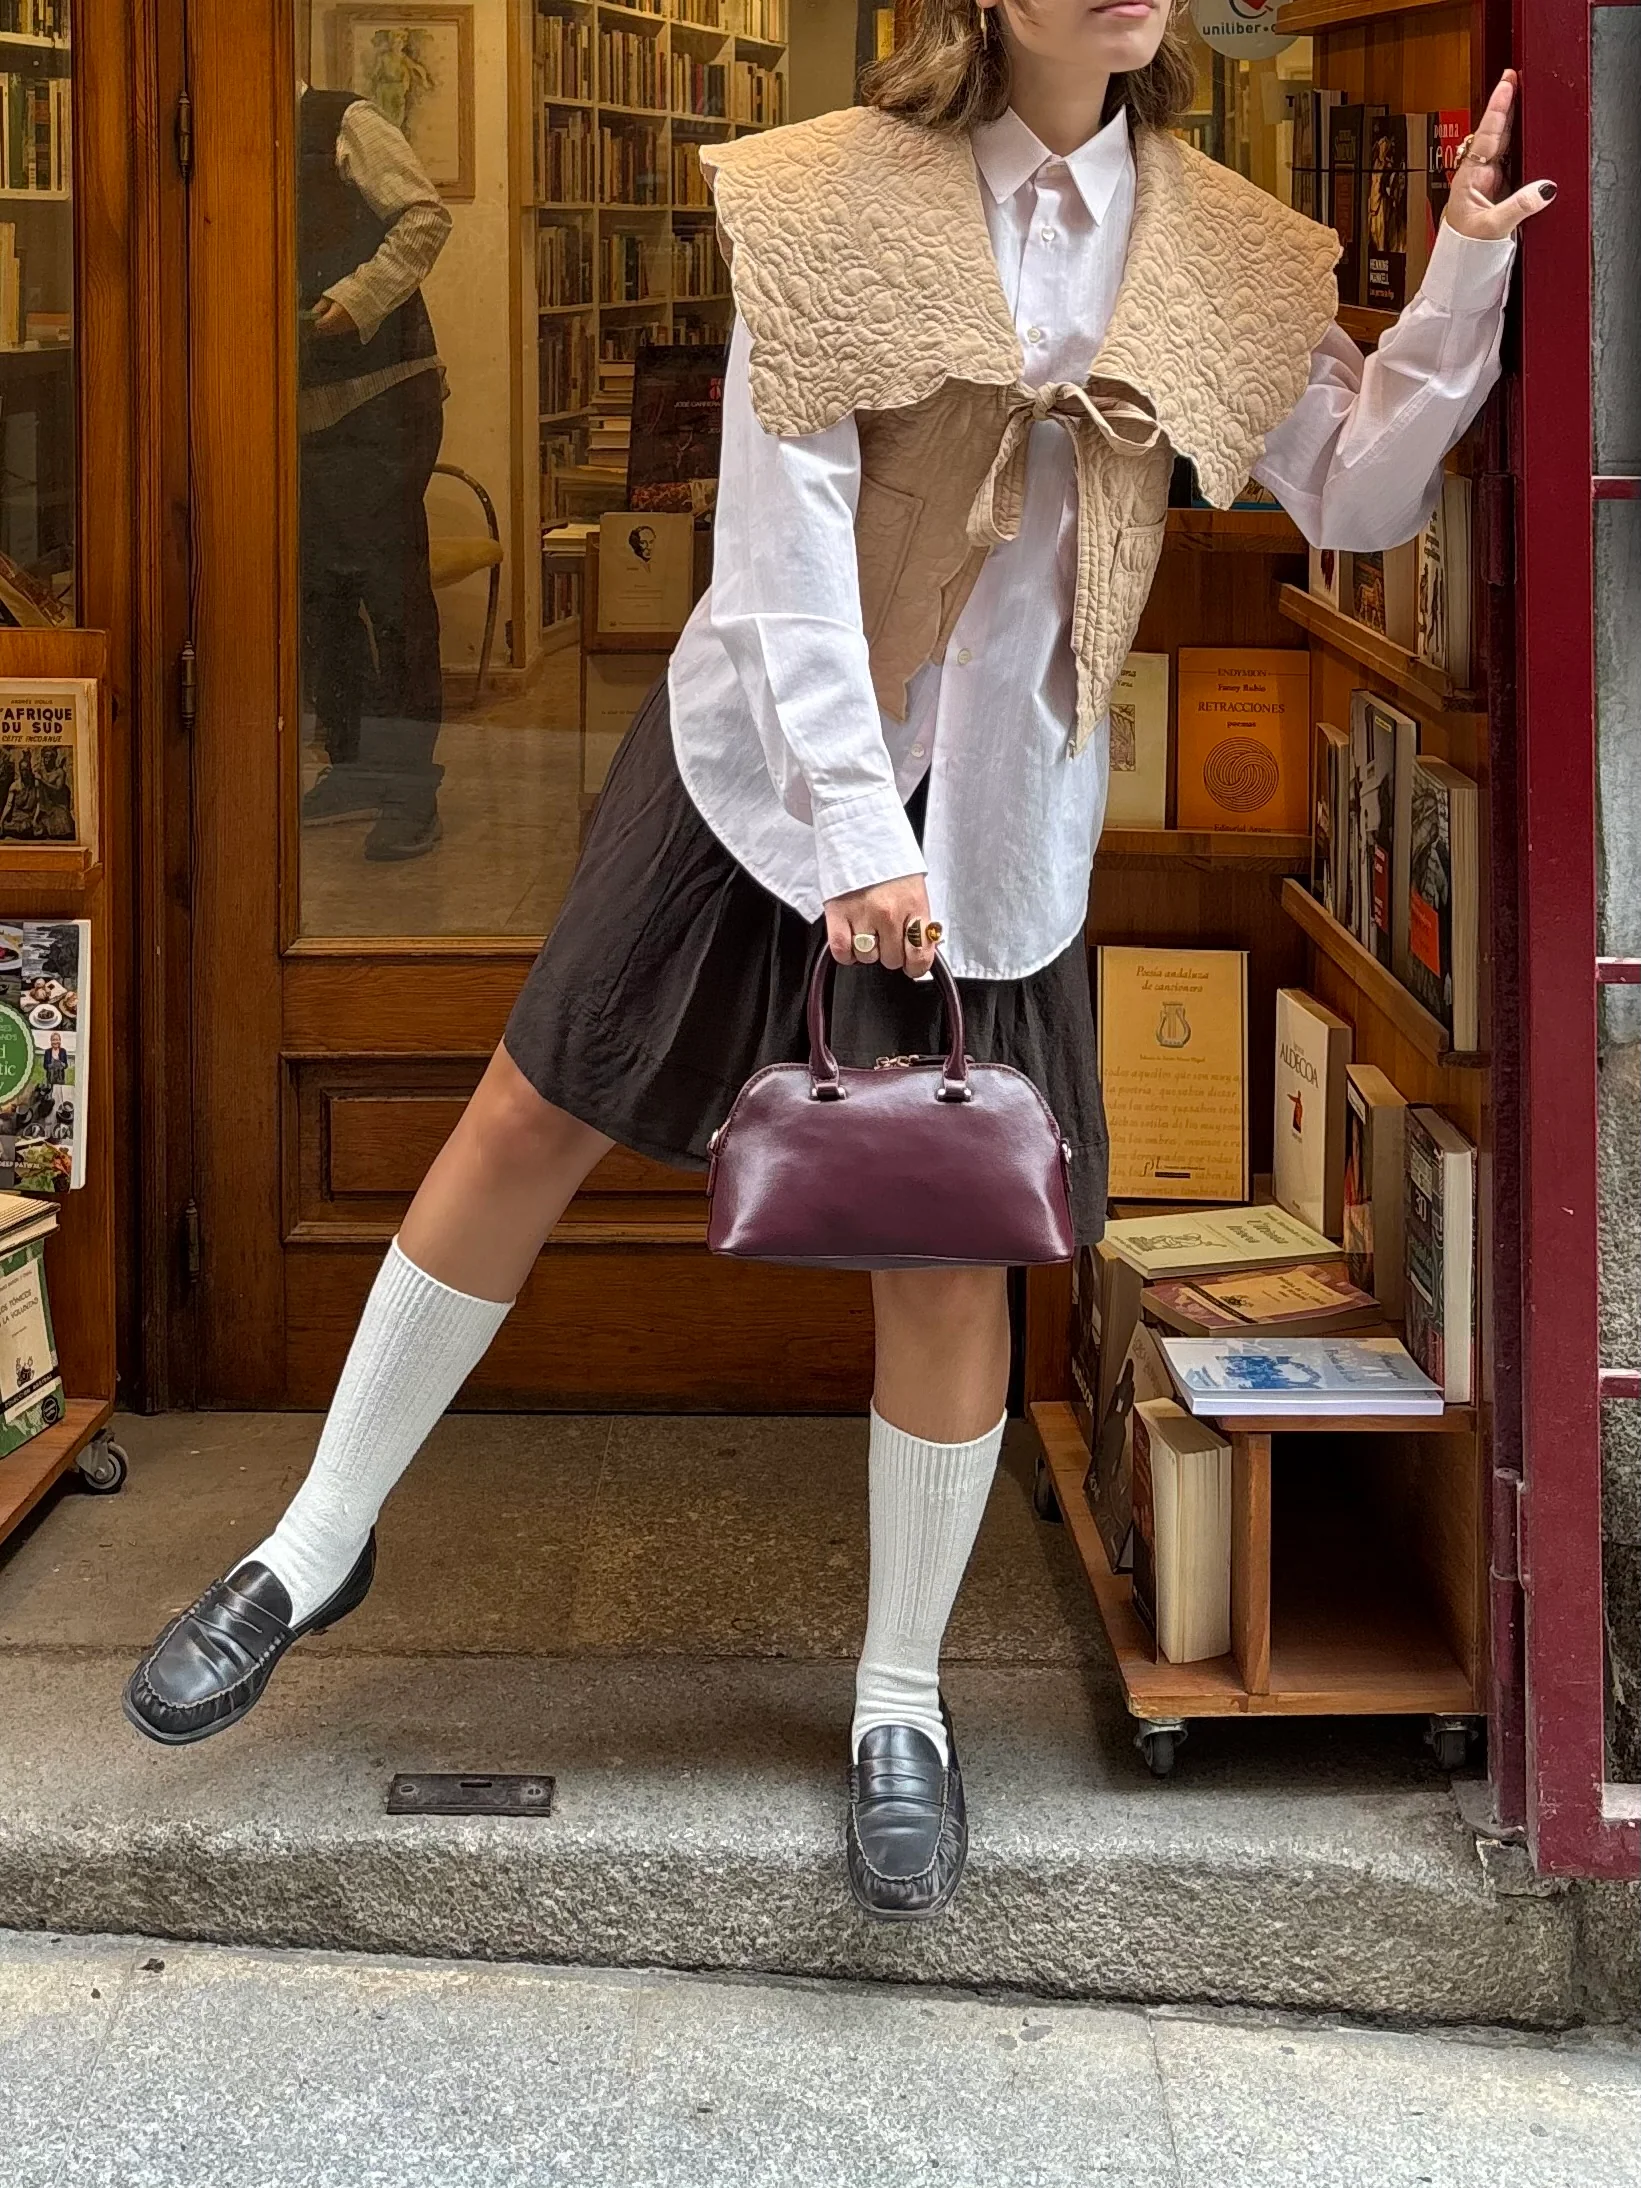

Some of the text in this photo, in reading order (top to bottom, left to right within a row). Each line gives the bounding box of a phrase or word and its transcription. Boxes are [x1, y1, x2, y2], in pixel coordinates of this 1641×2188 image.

[1197, 701, 1286, 714] RETRACCIONES
[2, 721, 63, 734] DU SUD
[1279, 1041, 1319, 1089] ALDECOA
